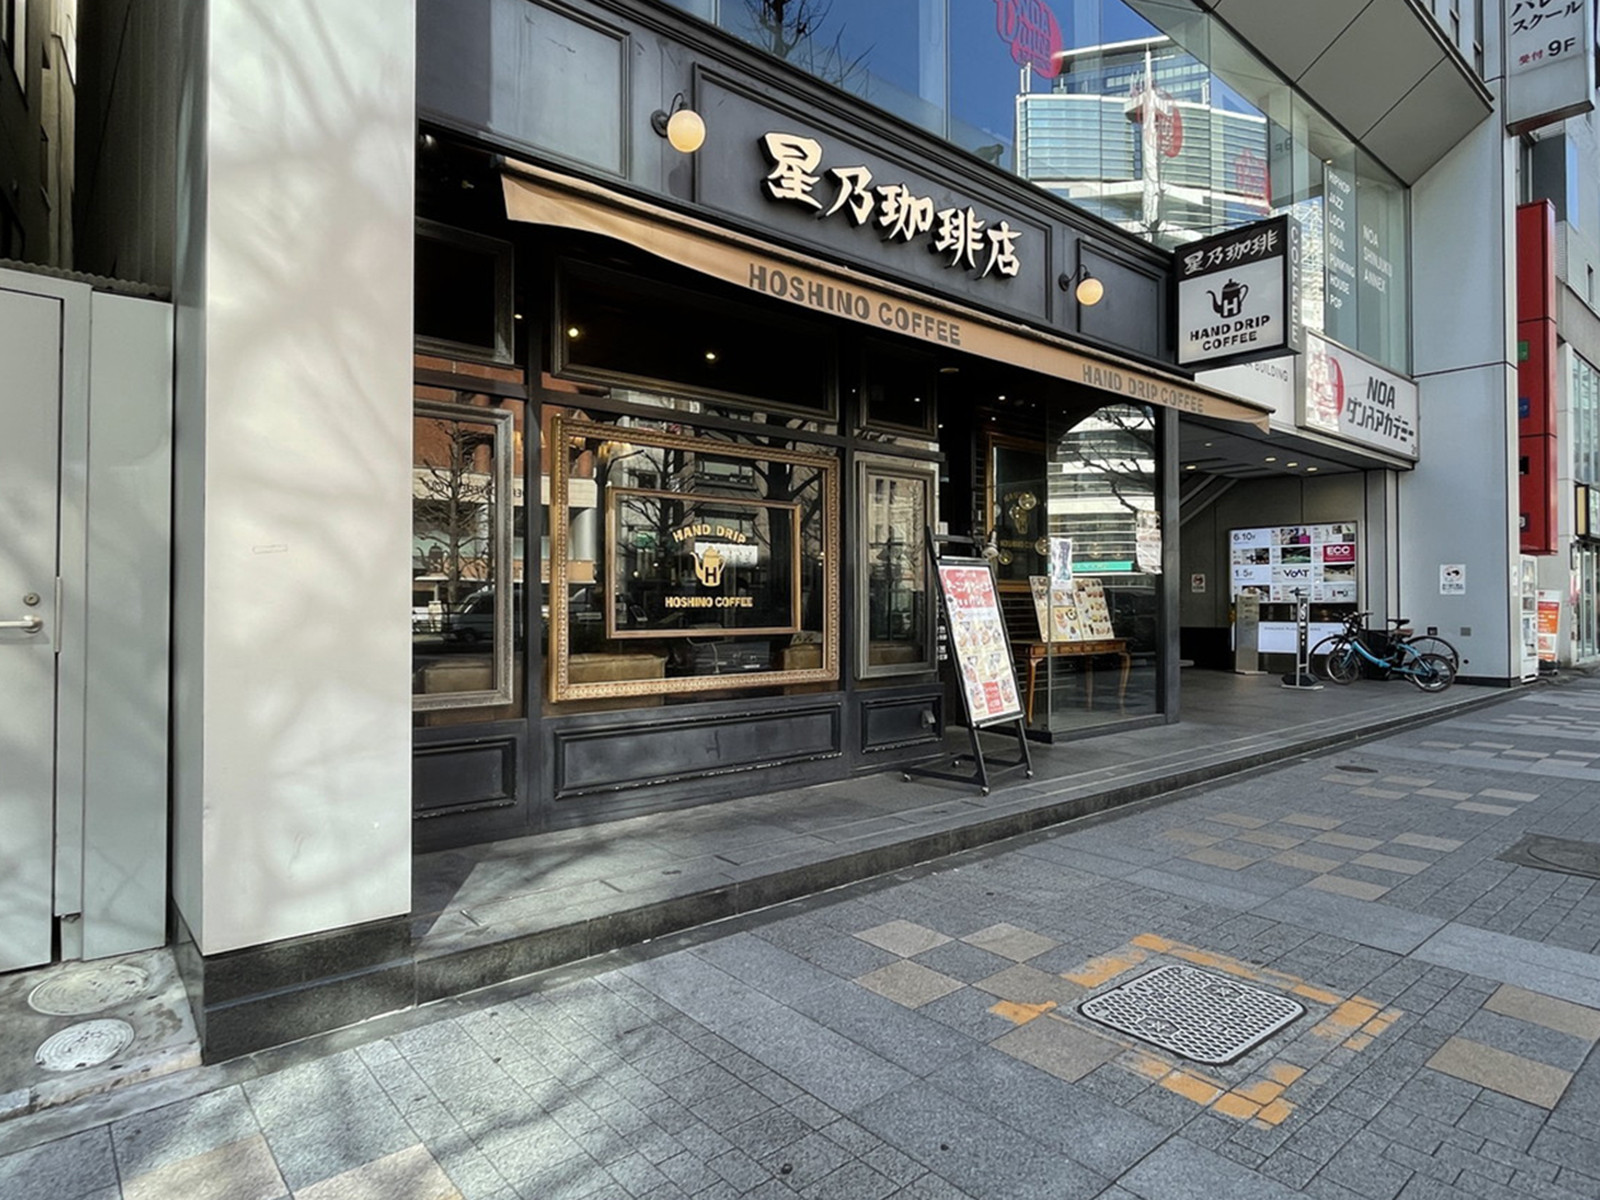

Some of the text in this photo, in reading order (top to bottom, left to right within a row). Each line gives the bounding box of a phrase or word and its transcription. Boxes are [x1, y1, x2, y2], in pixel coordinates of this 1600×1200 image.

[1511, 1, 1584, 35] スクール
[1548, 37, 1576, 56] 9F
[763, 132, 1022, 278] 星乃珈琲店
[1183, 229, 1278, 275] 星乃珈琲
[749, 263, 961, 346] HOSHINO COFFEE
[1190, 315, 1270, 341] HAND DRIP
[1202, 331, 1257, 351] COFFEE
[1082, 364, 1204, 413] HAND DRIP COFFEE
[1367, 376, 1395, 409] NOA
[672, 524, 747, 543] HAND DRIP
[665, 597, 753, 607] HOSHINO COFFEE
